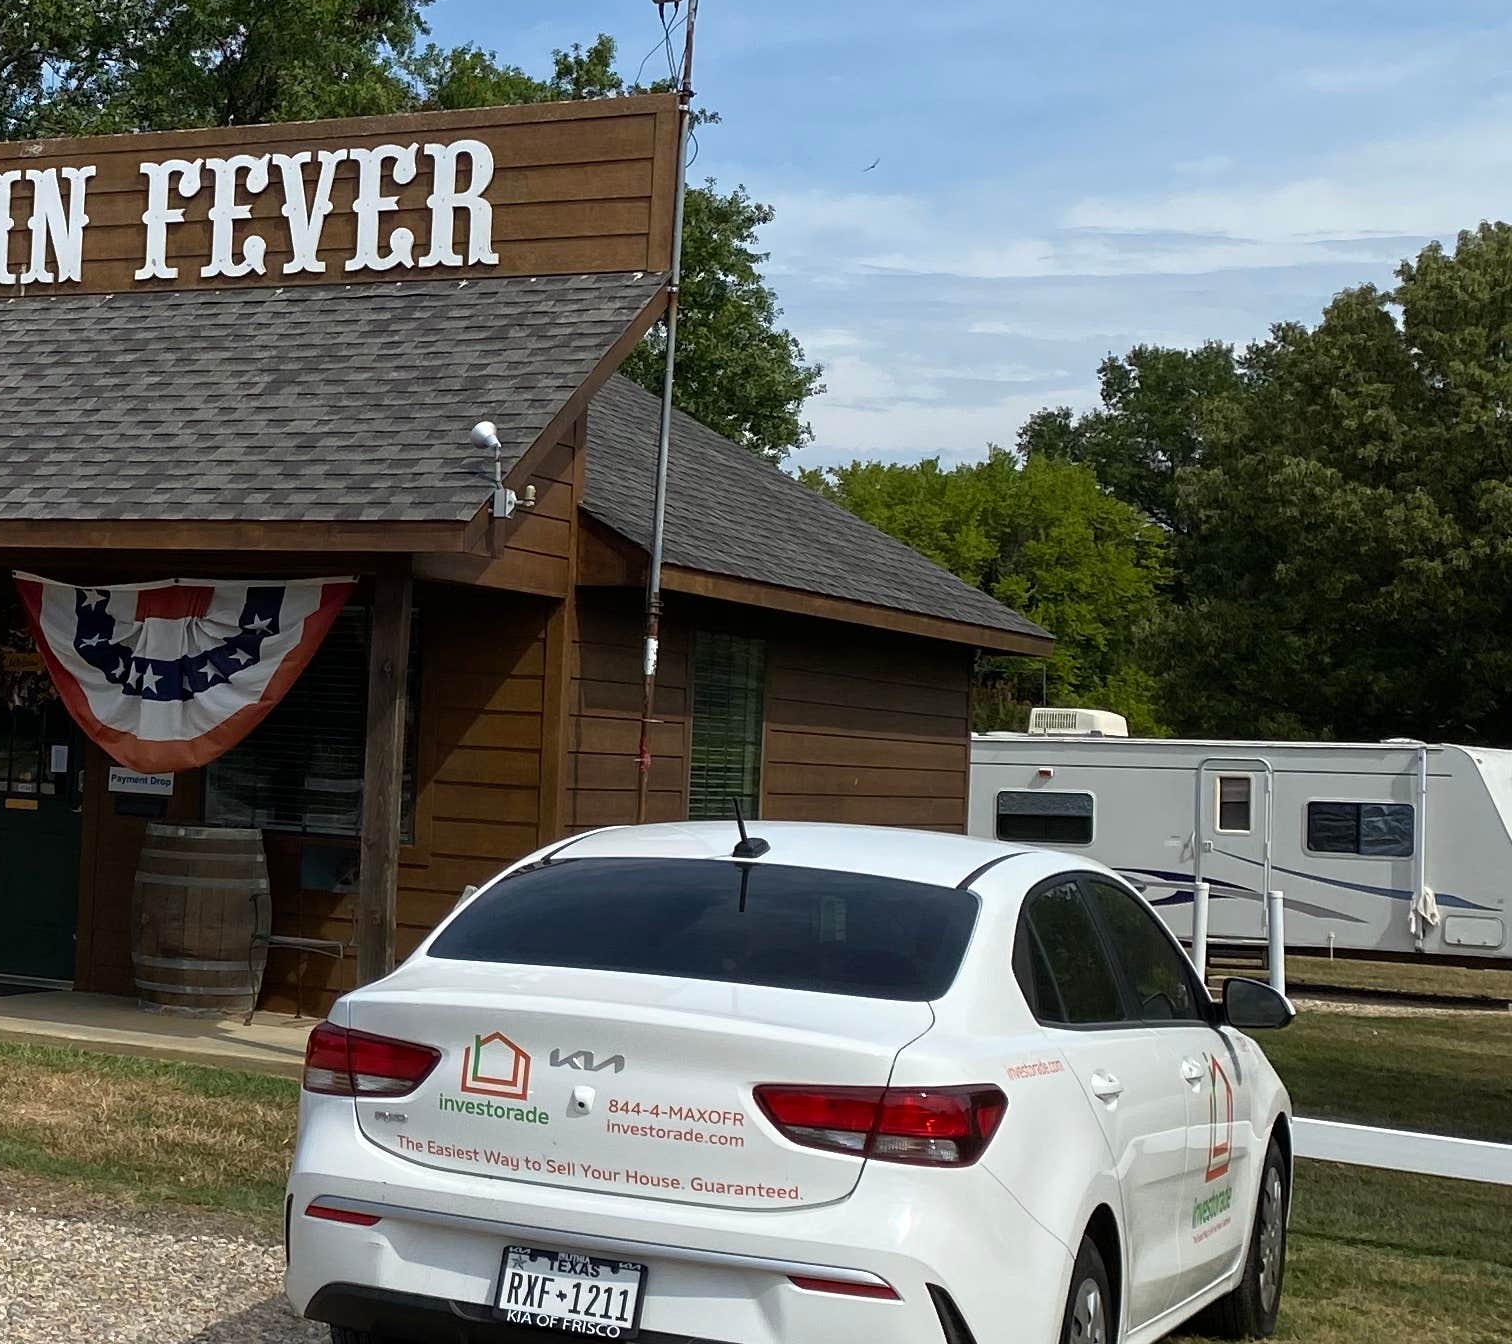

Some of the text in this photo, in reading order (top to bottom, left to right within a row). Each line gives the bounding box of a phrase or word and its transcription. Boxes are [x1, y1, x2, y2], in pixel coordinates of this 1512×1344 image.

[134, 139, 500, 281] FEVER
[111, 773, 172, 788] Payment Drop
[438, 1092, 550, 1125] investorade
[607, 1099, 745, 1127] 844-4-MAXOFR
[606, 1119, 745, 1147] investorade.com
[396, 1134, 804, 1200] The Easiest Way to Sell Your House. Guaranteed.
[549, 1258, 601, 1278] TEXAS
[506, 1309, 621, 1339] KIA OF FRISCO
